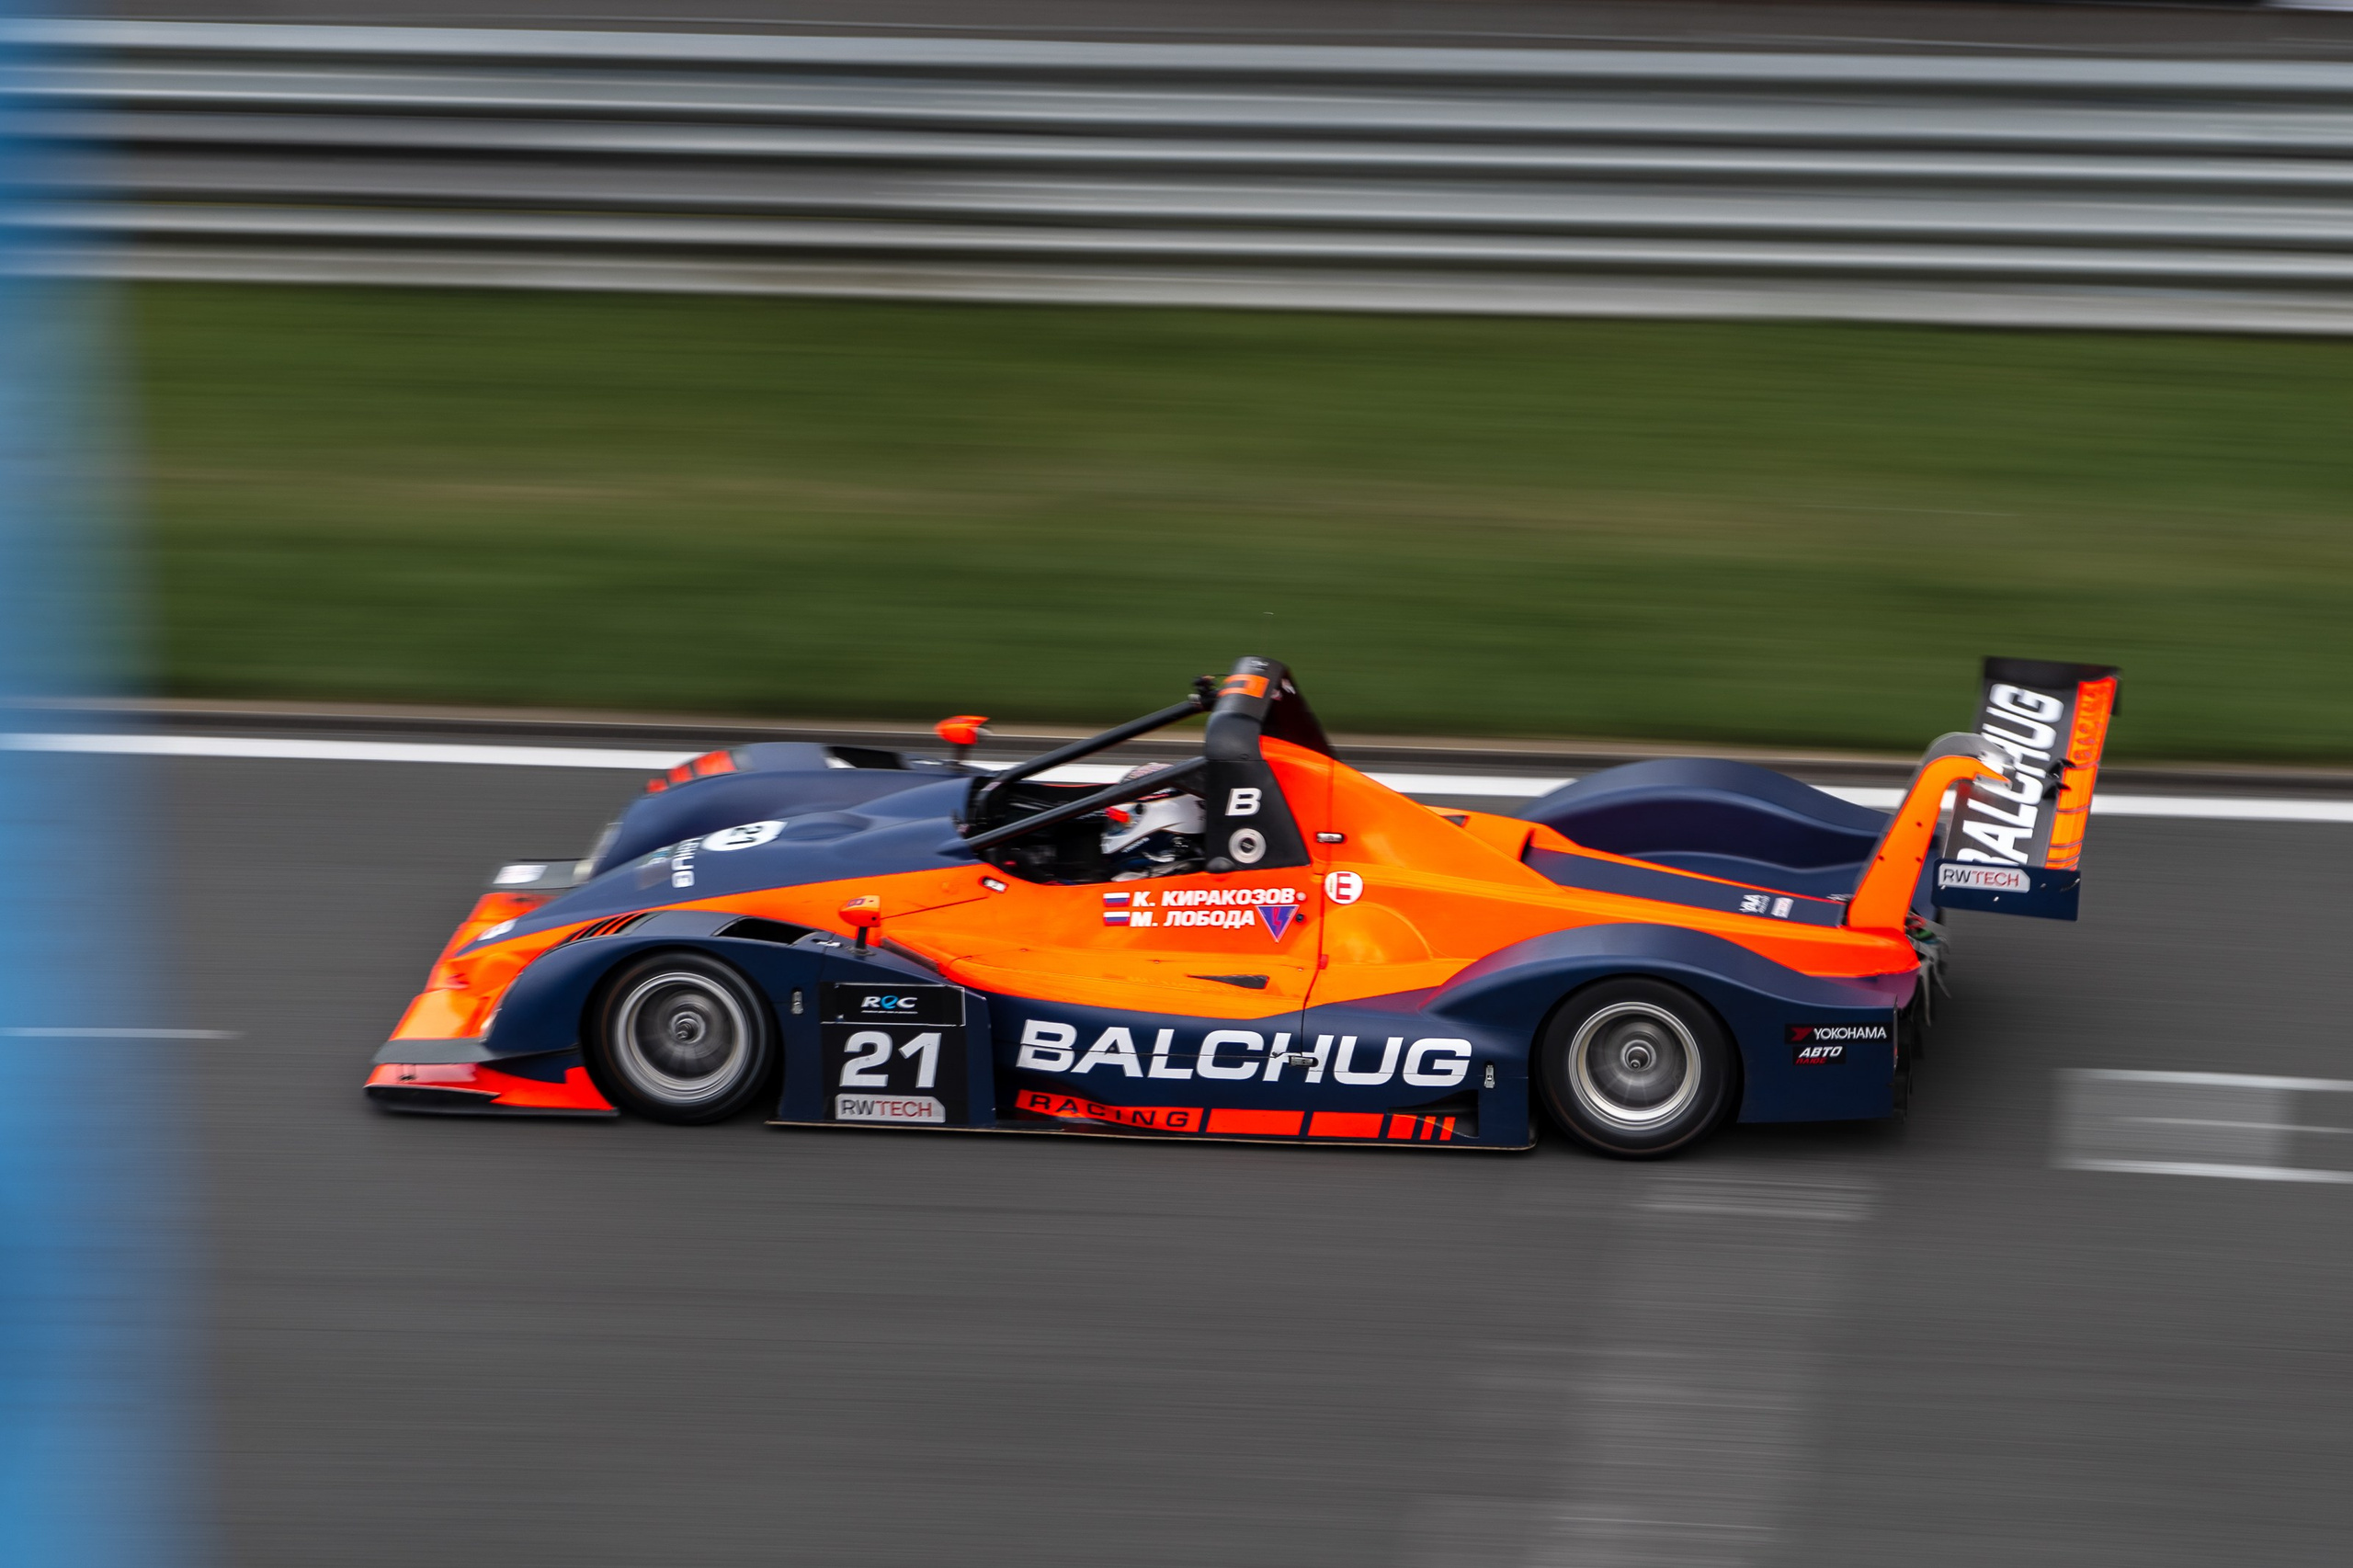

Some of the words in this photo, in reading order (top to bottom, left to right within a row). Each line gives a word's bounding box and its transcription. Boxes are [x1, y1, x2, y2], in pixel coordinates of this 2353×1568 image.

[1225, 788, 1262, 816] B
[1336, 873, 1351, 900] E
[1942, 868, 2019, 888] RWTECH
[1131, 891, 1155, 907] К.
[1161, 888, 1296, 906] КИРАКОЗОВ
[1130, 911, 1158, 927] М.
[1163, 910, 1256, 929] ЛОБОДА
[1813, 1027, 1887, 1040] YOKOHAMA
[838, 1030, 942, 1088] 21
[1016, 1019, 1472, 1086] BALCHUG
[841, 1099, 933, 1118] RWTECH
[1029, 1095, 1189, 1128] RACING
